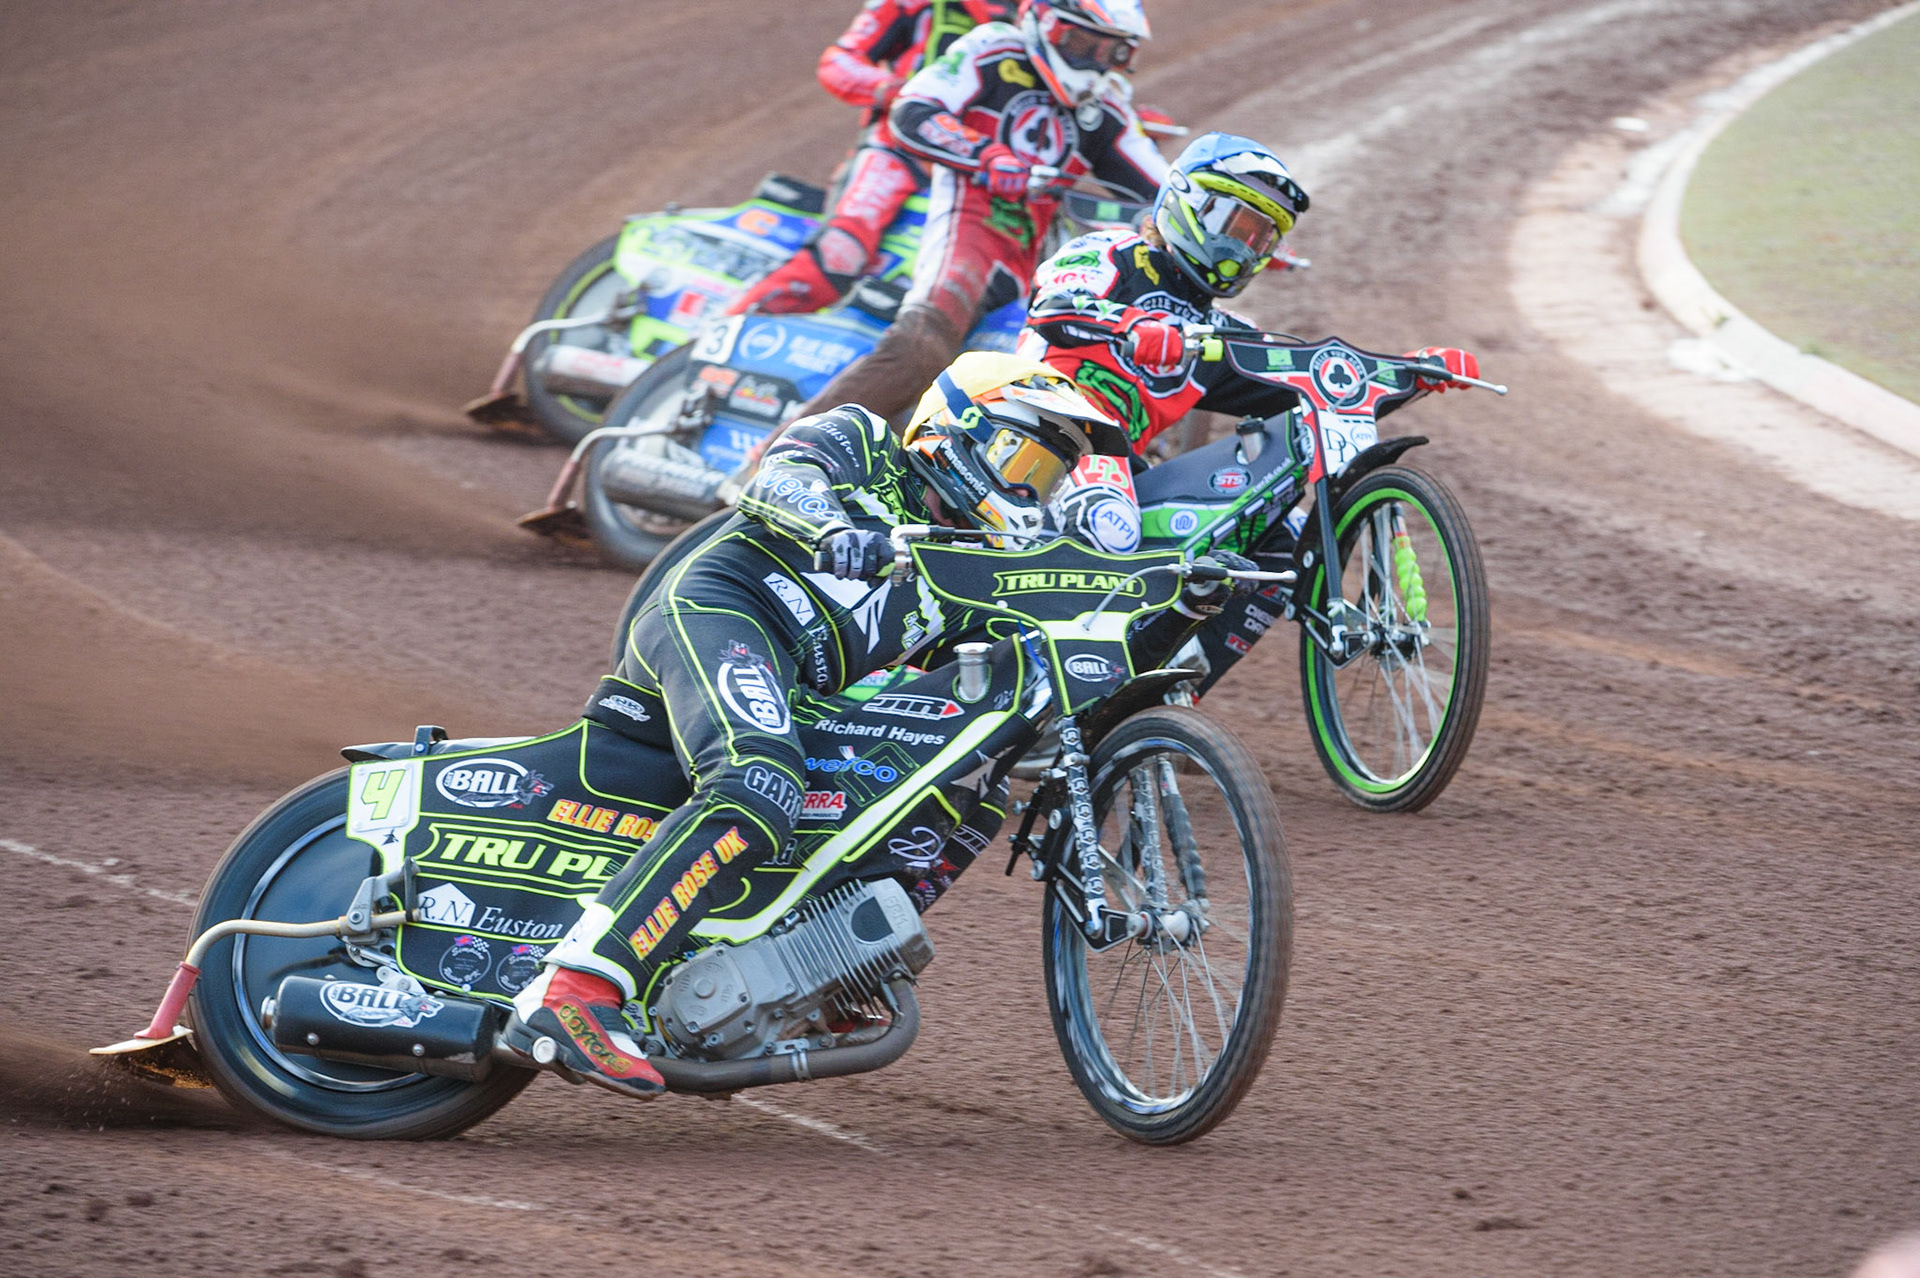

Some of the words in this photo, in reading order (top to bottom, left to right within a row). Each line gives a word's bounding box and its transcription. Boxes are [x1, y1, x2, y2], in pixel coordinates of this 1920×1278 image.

[706, 325, 729, 355] 3
[940, 438, 988, 497] Panasonic
[1100, 510, 1135, 541] ATPI
[1003, 573, 1056, 590] TRU
[1059, 573, 1138, 593] PLANT
[1071, 660, 1109, 674] BALL
[733, 664, 781, 721] BALL
[814, 719, 887, 738] Richard
[887, 725, 946, 746] Hayes
[360, 769, 405, 820] 4
[449, 769, 520, 794] BALL
[546, 798, 620, 833] ELLIE
[612, 812, 660, 843] ROS
[439, 832, 547, 869] TRU
[629, 896, 680, 961] ELLIE
[671, 850, 720, 912] ROSE
[713, 826, 749, 864] UK
[472, 905, 564, 939] Euston
[338, 985, 406, 1010] BALL
[558, 1003, 634, 1075] daytona
